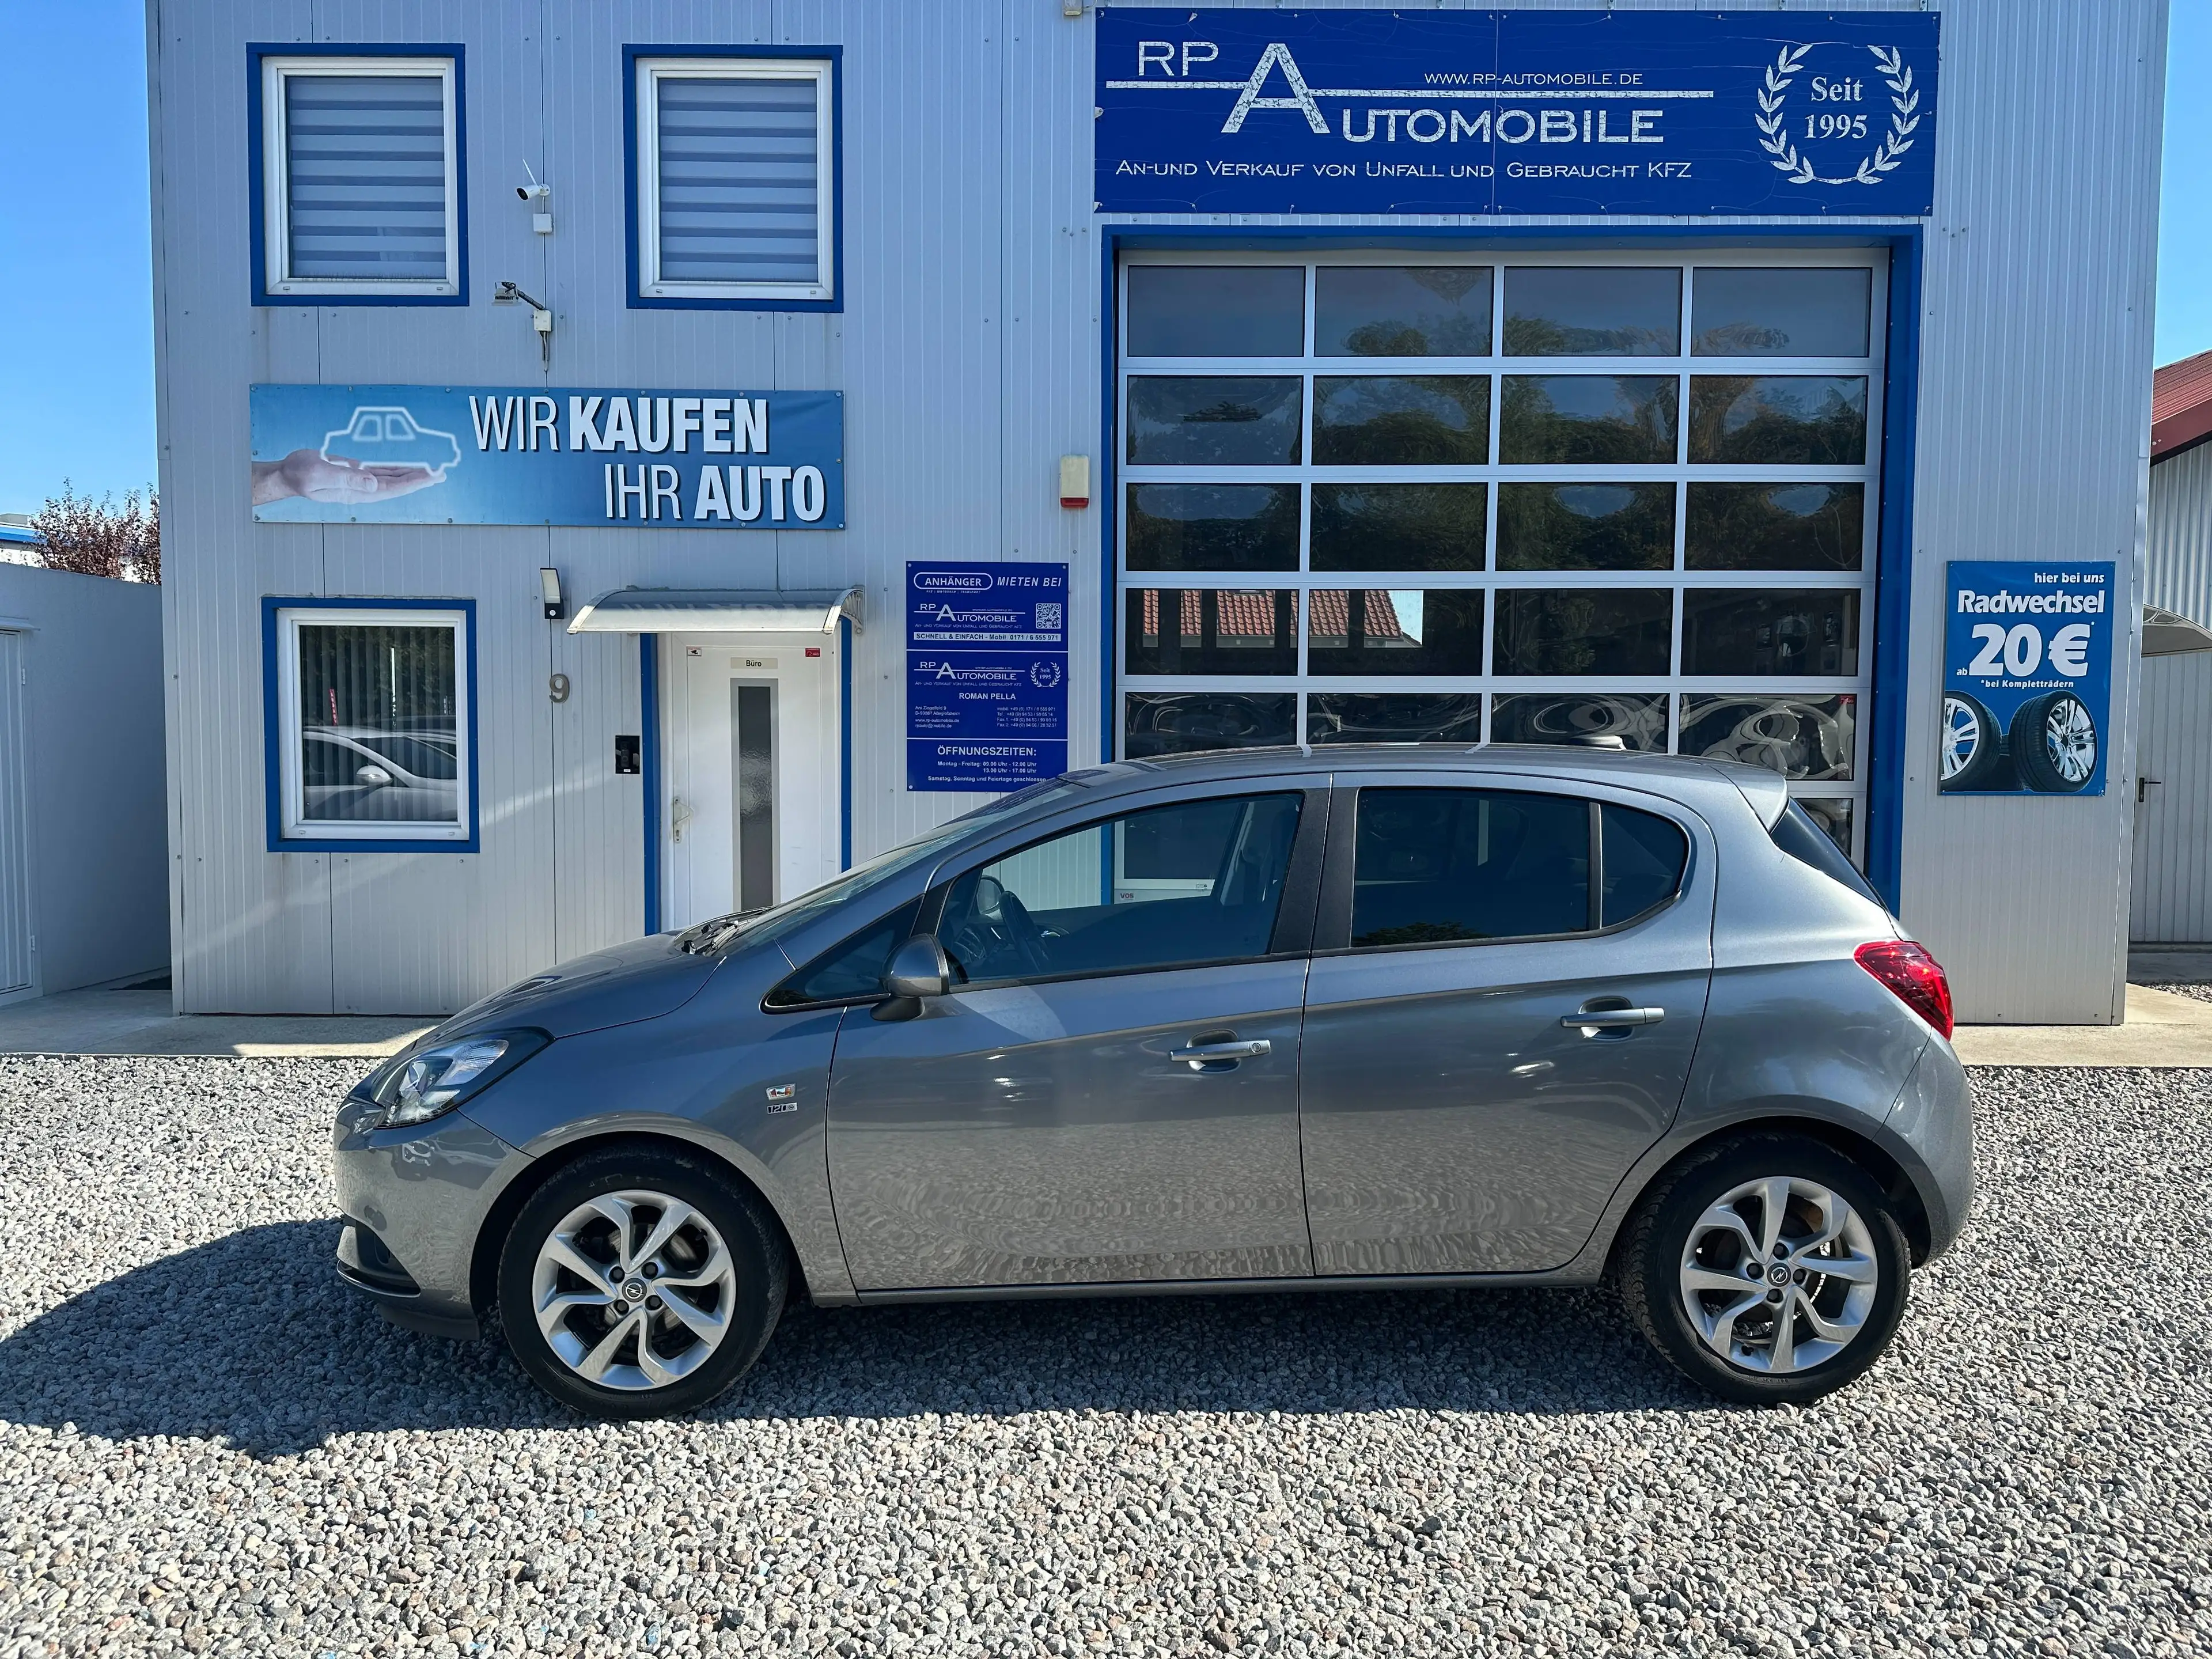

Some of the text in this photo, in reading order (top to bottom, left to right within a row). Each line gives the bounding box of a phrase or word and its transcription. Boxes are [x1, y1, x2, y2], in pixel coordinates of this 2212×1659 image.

[1424, 73, 1643, 85] WWW.RP-AUTOMOBILE.DE
[1138, 41, 1664, 143] RP AUTOMOBILE
[1810, 77, 1863, 102] Seit
[1804, 114, 1868, 139] 1995
[1206, 160, 1304, 176] VERKAUF
[1313, 164, 1356, 176] VON
[1366, 162, 1444, 177] UNFALL
[1450, 165, 1494, 177] UND
[1507, 162, 1639, 178] GEBRAUCHT
[1647, 162, 1692, 178] KFZ
[469, 396, 768, 453] WIR KAUFEN
[605, 464, 825, 521] IHR AUTO
[925, 576, 1062, 586] ANHÄNGER MIETEN BEI
[2035, 573, 2104, 584] hier bei uns
[1958, 590, 2105, 613] Radwechsel
[936, 604, 1017, 622] AUTOMOBILE
[1957, 668, 1967, 676] ab
[1969, 623, 2042, 677] 20
[936, 662, 1017, 680] AUTOMOBILE
[550, 673, 570, 704] 9
[2002, 680, 2074, 688] Kompletträdern
[938, 745, 1036, 756] ÖFFNUNGSZEITEN:
